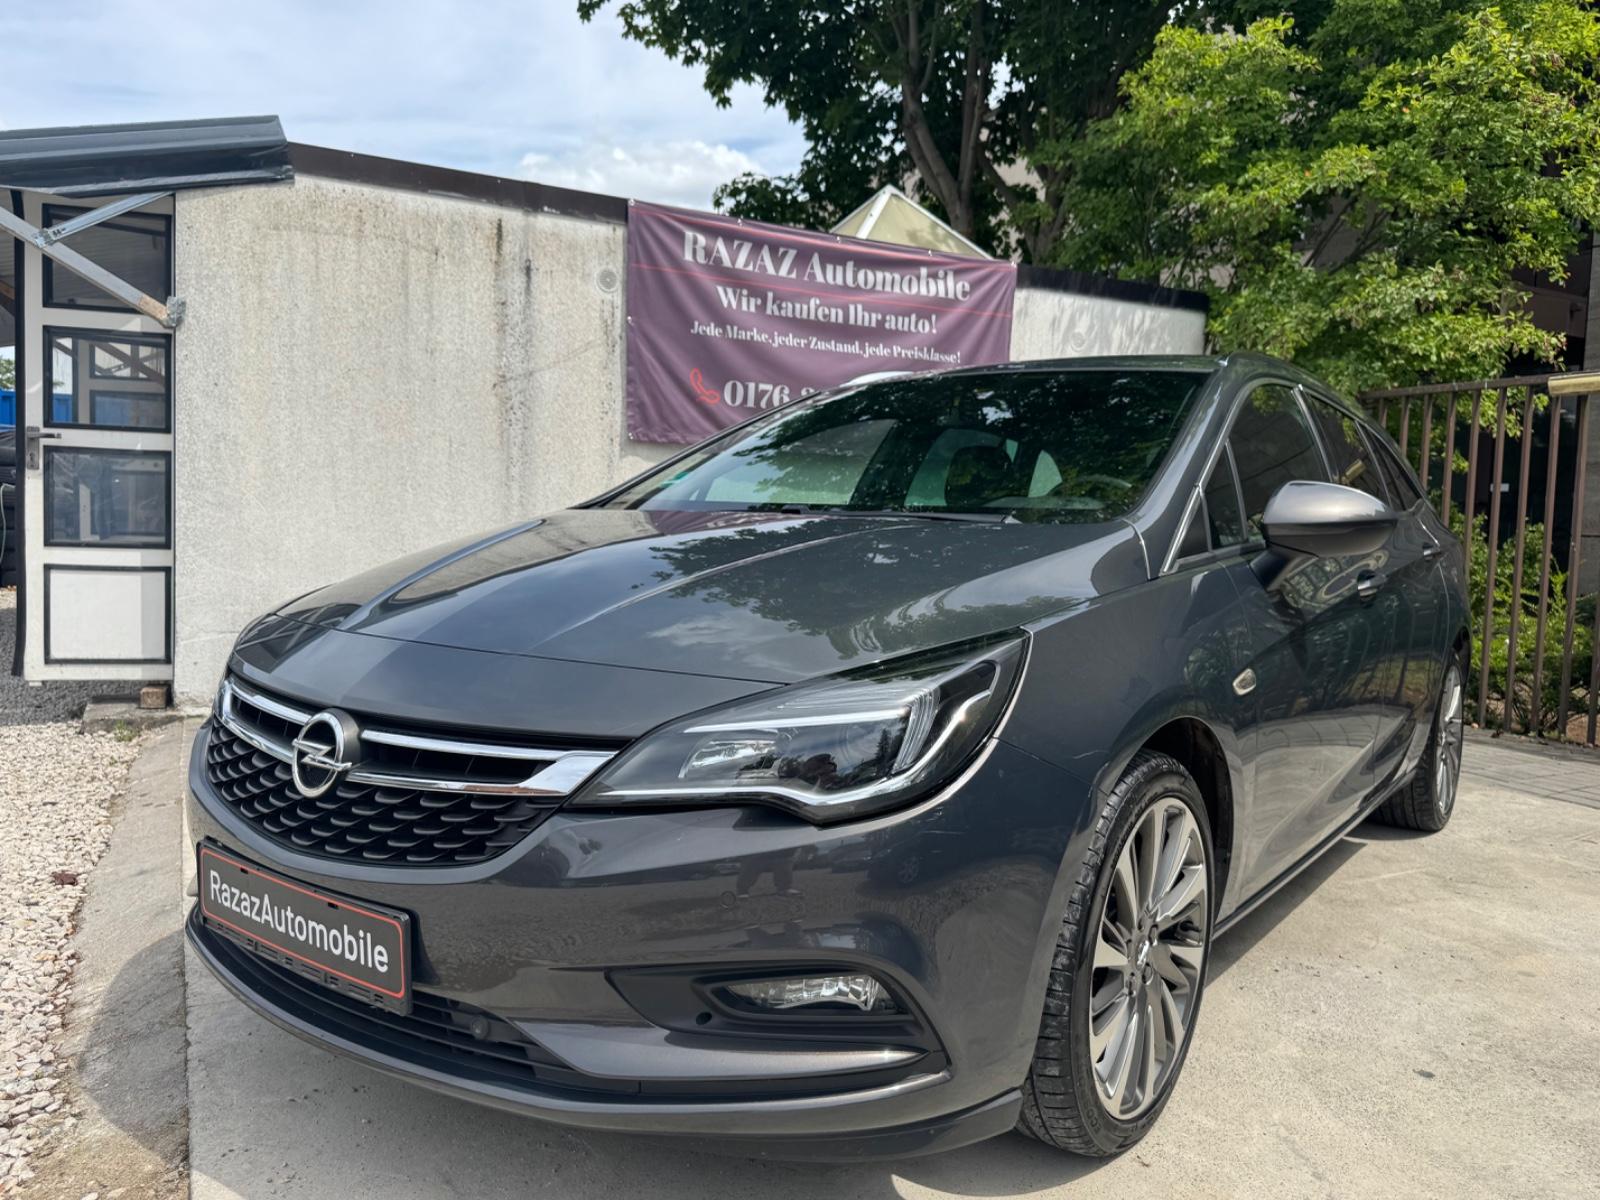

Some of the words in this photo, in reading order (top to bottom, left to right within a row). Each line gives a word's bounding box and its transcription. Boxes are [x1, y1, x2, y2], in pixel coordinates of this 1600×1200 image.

[683, 230, 798, 280] RAZAZ
[803, 251, 971, 301] Automobile
[716, 285, 762, 314] Wir
[765, 291, 844, 325] kaufen
[848, 303, 882, 328] Ihr
[884, 313, 937, 334] auto!
[690, 320, 723, 337] Jede
[893, 345, 961, 364] Preisklasse!
[723, 380, 790, 409] 0176
[209, 869, 389, 973] RazazAutomobile
